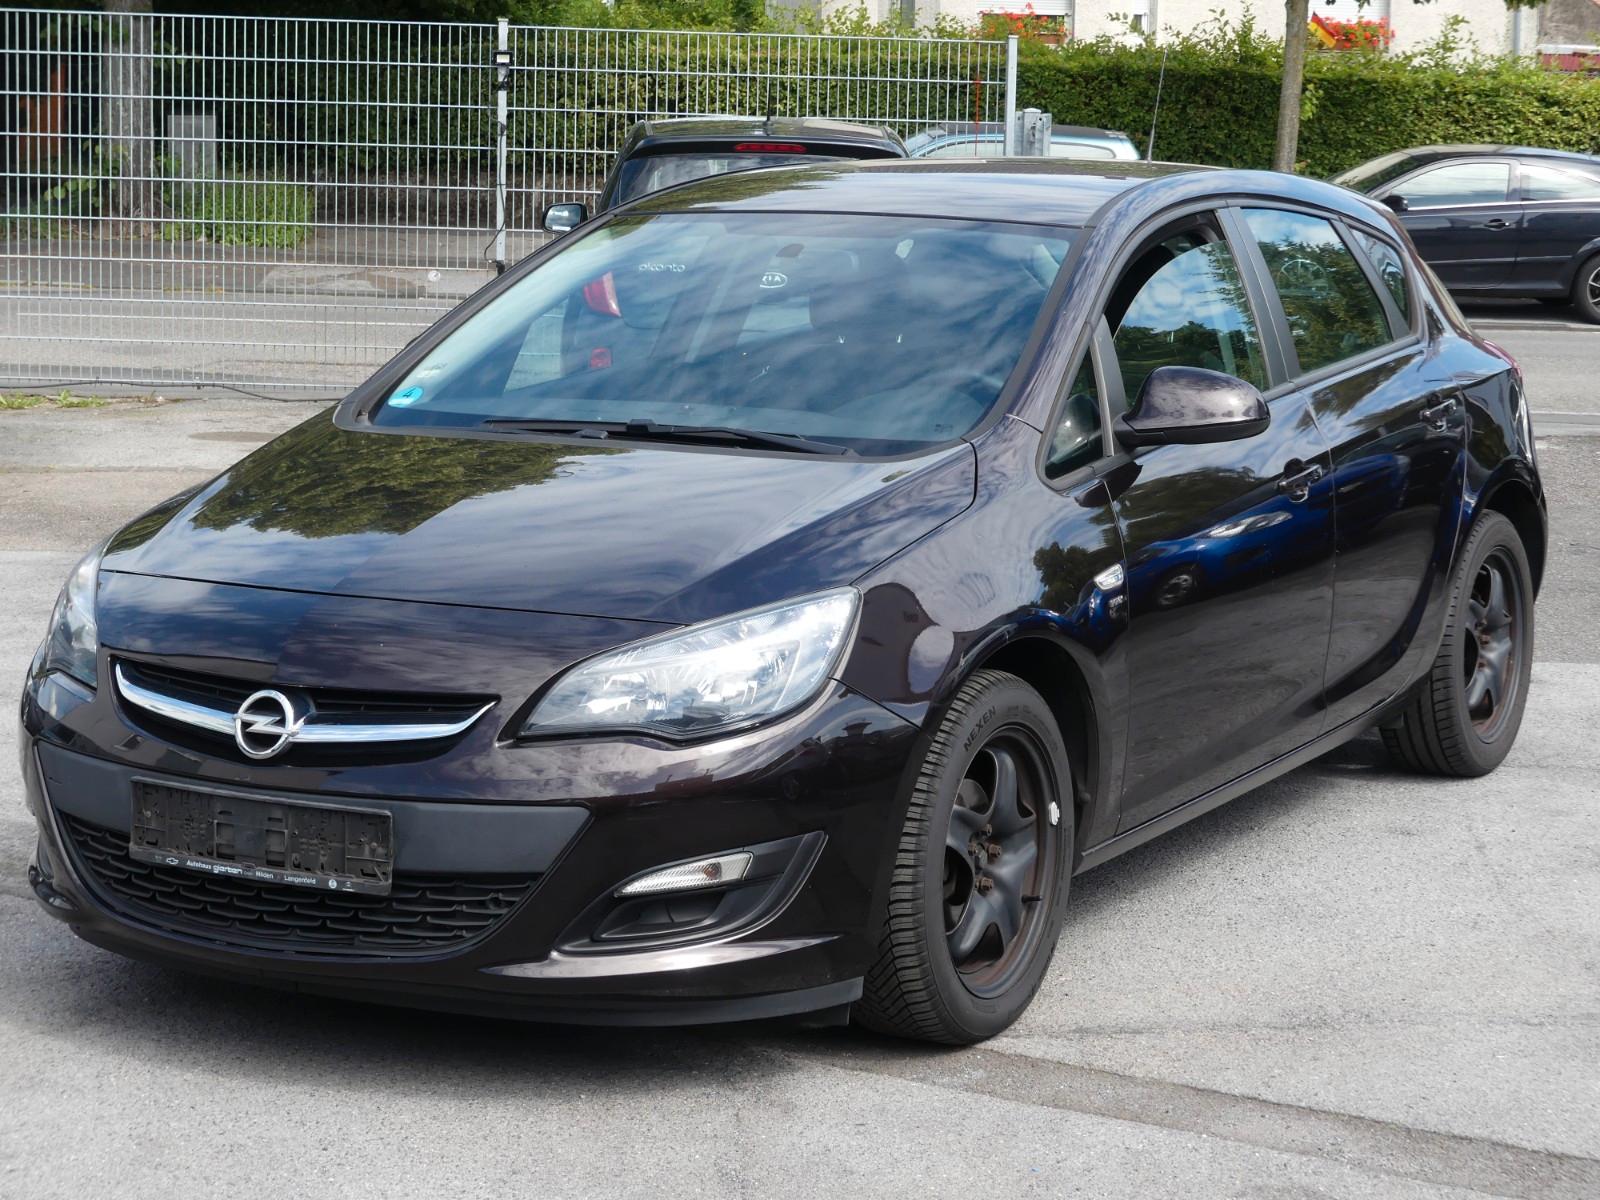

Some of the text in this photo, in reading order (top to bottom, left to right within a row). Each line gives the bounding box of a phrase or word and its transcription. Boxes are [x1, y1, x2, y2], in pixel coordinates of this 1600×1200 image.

[963, 706, 997, 752] NEXEN
[185, 859, 212, 870] Autohaus
[284, 874, 317, 885] Langenfeld
